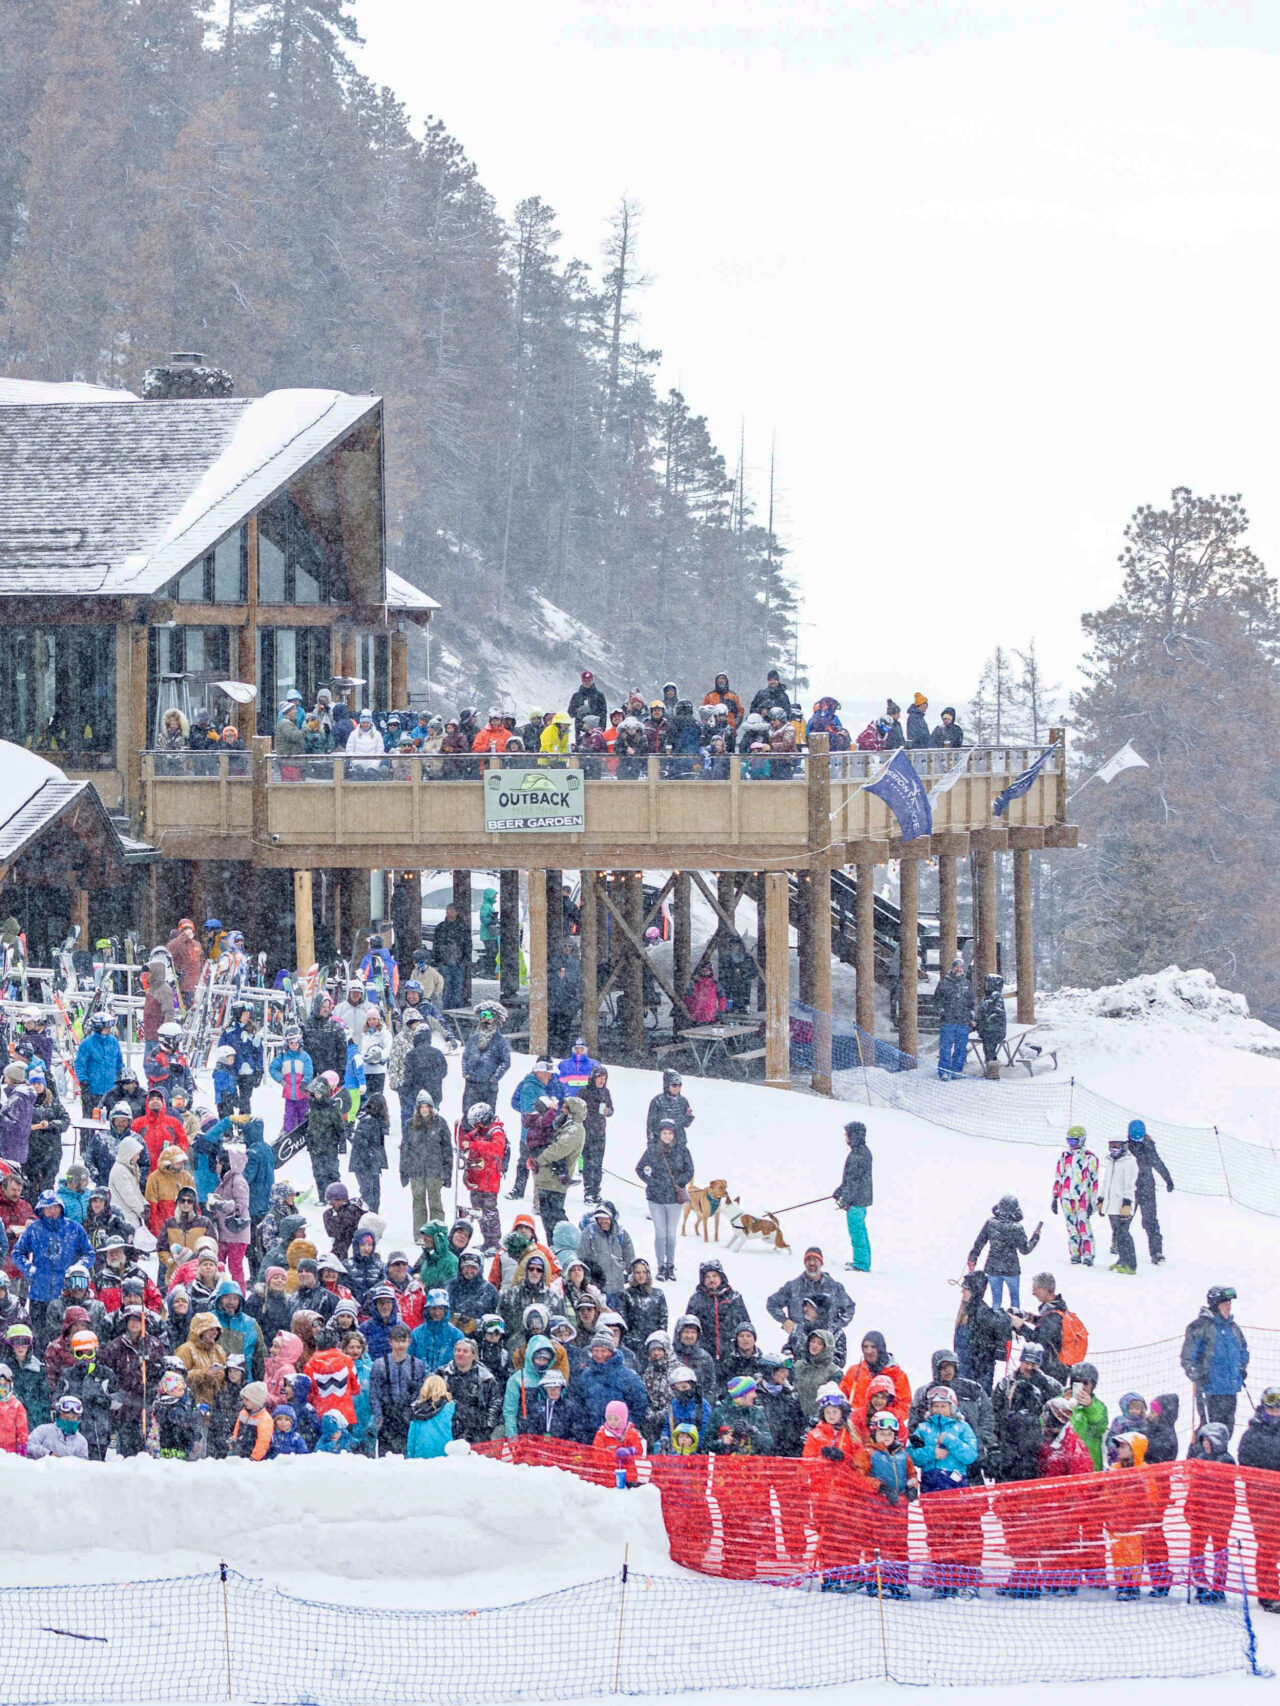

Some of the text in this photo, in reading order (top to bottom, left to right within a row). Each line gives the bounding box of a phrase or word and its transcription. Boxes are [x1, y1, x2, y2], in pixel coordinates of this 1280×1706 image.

[499, 792, 570, 809] OUTBACK
[488, 816, 582, 830] BEER GARDEN
